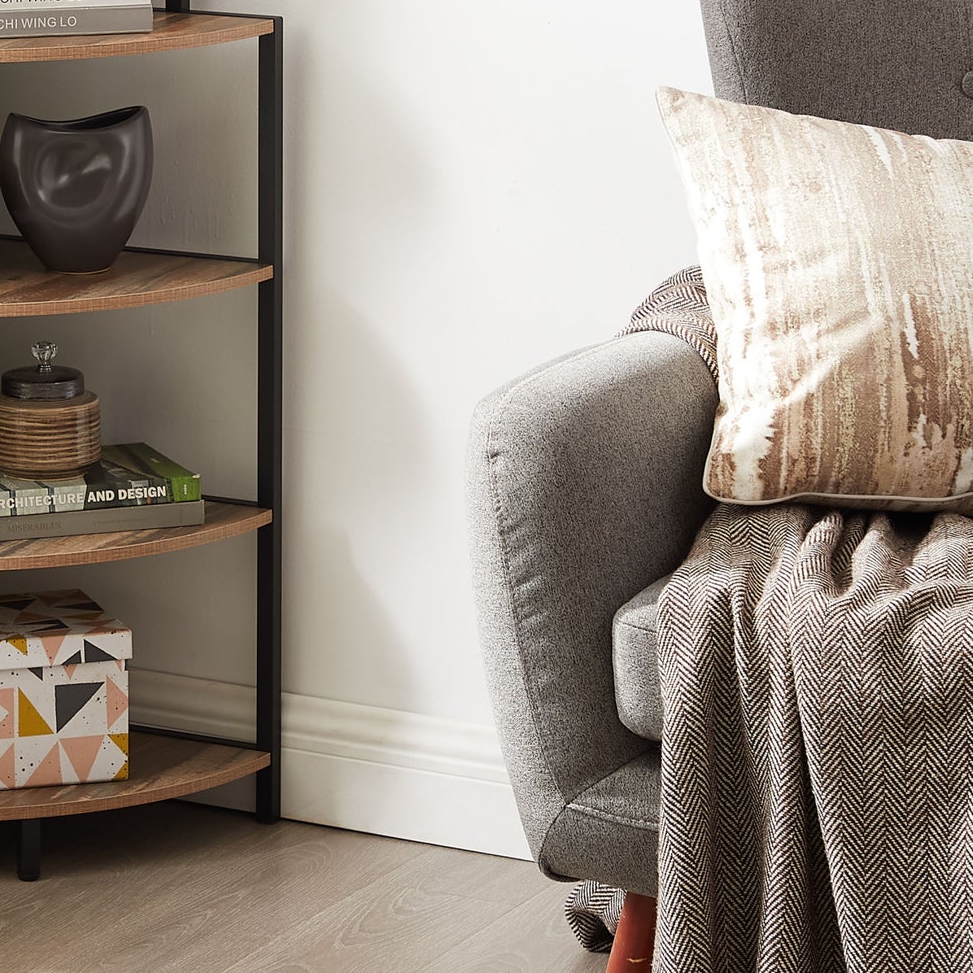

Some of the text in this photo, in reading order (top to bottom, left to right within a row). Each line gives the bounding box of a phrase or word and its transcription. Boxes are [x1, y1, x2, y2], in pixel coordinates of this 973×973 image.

[21, 16, 57, 29] WING
[60, 15, 77, 27] LO
[87, 489, 115, 504] AND
[118, 485, 167, 501] DESIGN
